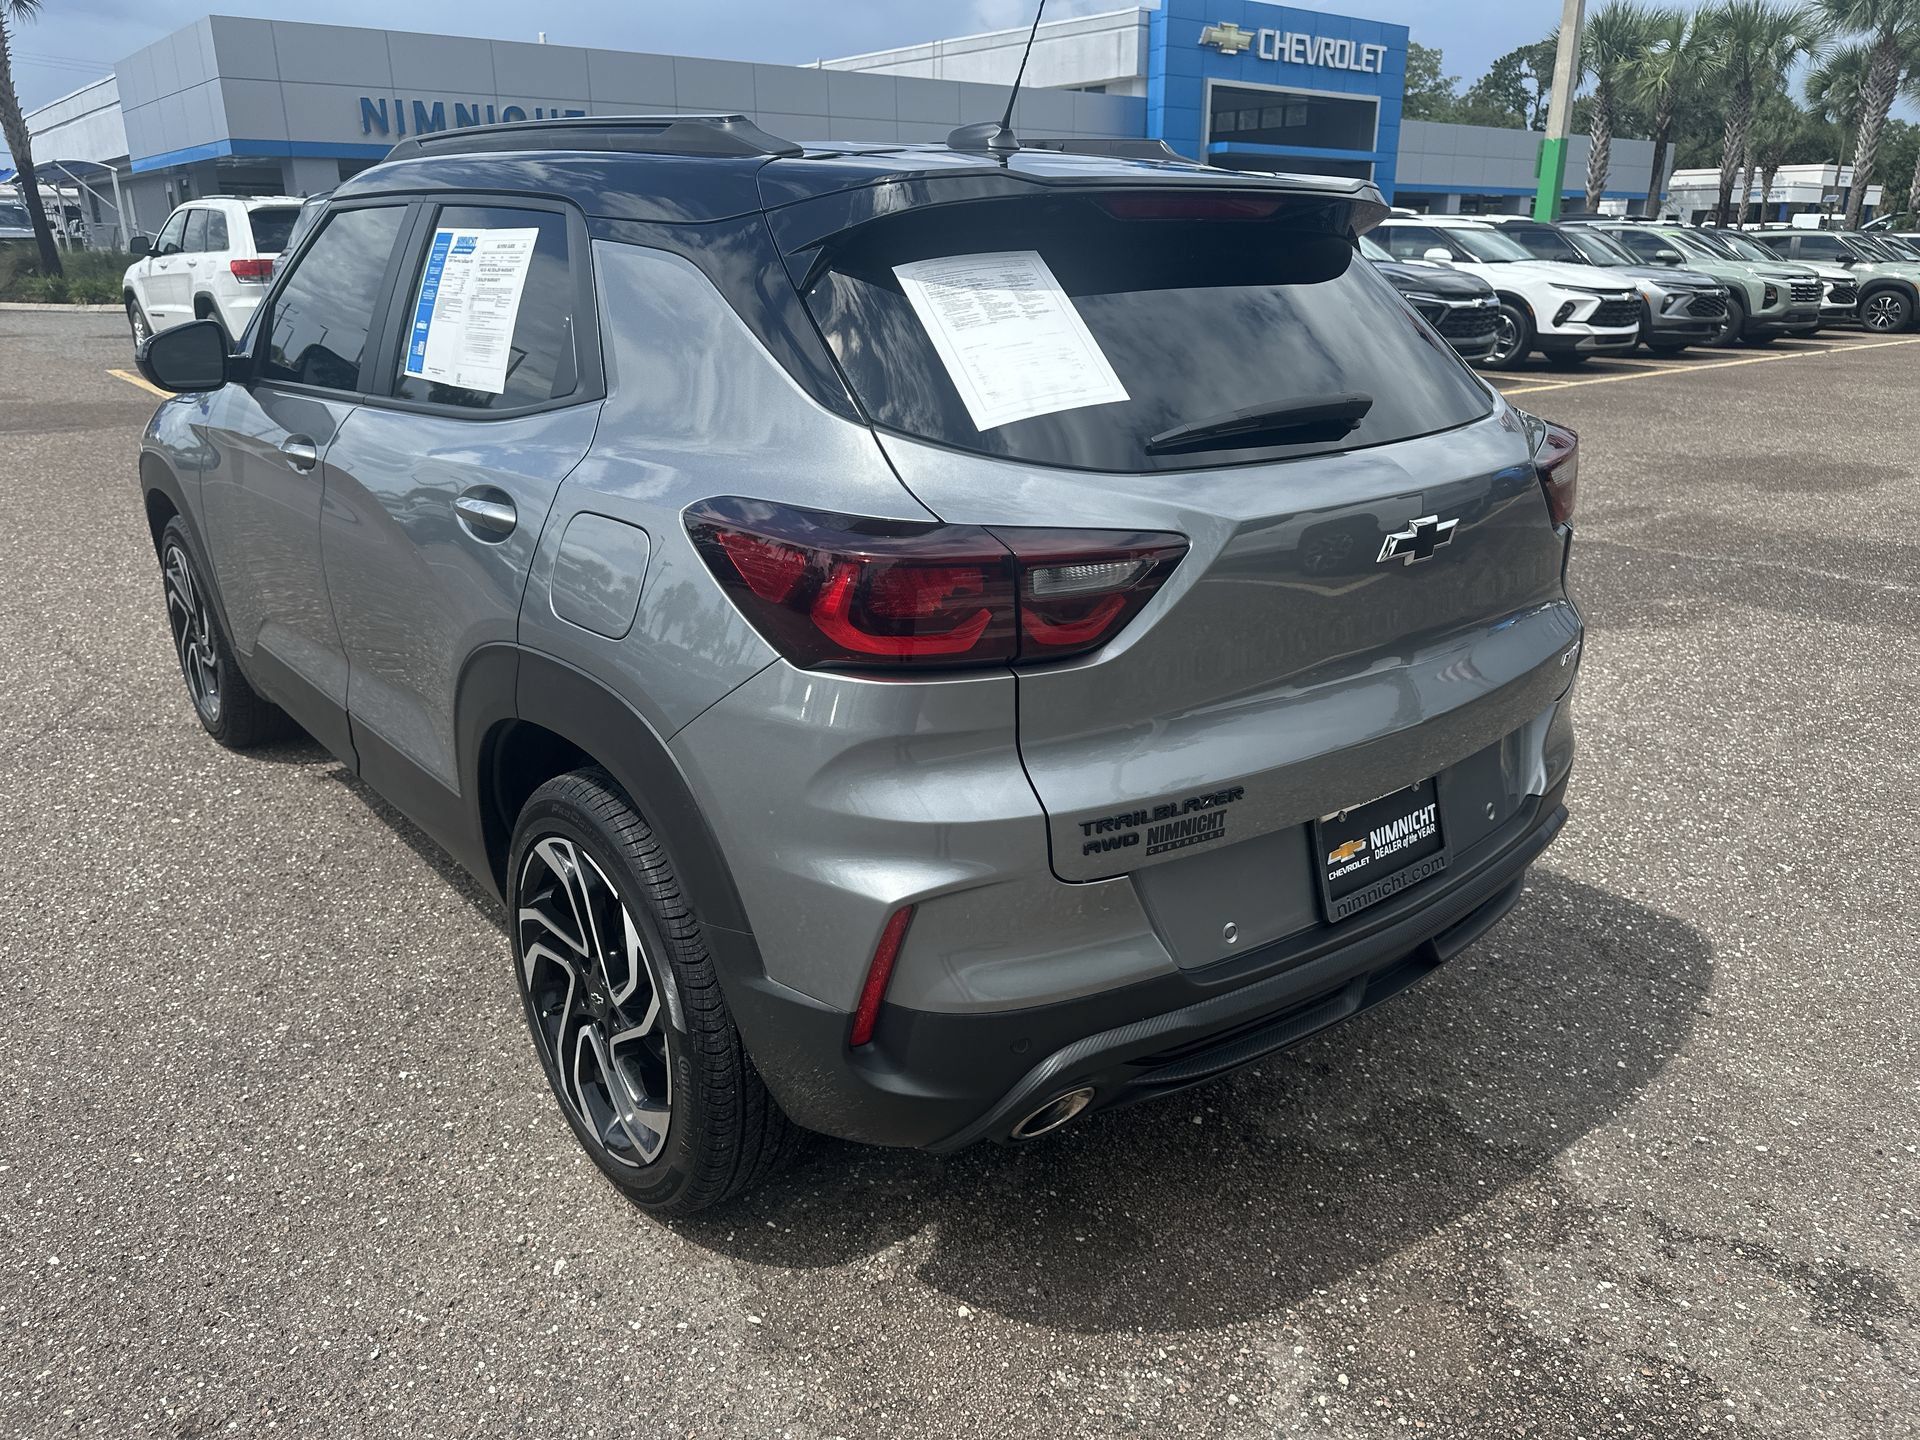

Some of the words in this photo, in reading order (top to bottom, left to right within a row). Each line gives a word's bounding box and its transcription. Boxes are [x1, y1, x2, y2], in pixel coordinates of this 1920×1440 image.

[1258, 28, 1387, 74] CHEVROLET
[359, 97, 586, 136] NIMNI
[1078, 785, 1245, 837] TRAILBLAZER
[1146, 809, 1228, 847] NIMNICHT
[1369, 803, 1436, 850] NIMNICHT
[1082, 832, 1140, 856] AWD
[1147, 829, 1225, 856] CHEVROLET
[1374, 839, 1402, 860] DEALER
[1402, 834, 1409, 848] of
[1408, 833, 1418, 844] the
[1417, 823, 1436, 840] YEAR
[1328, 856, 1370, 881] CHEVROLET
[1336, 856, 1445, 918] nimnicht.com
